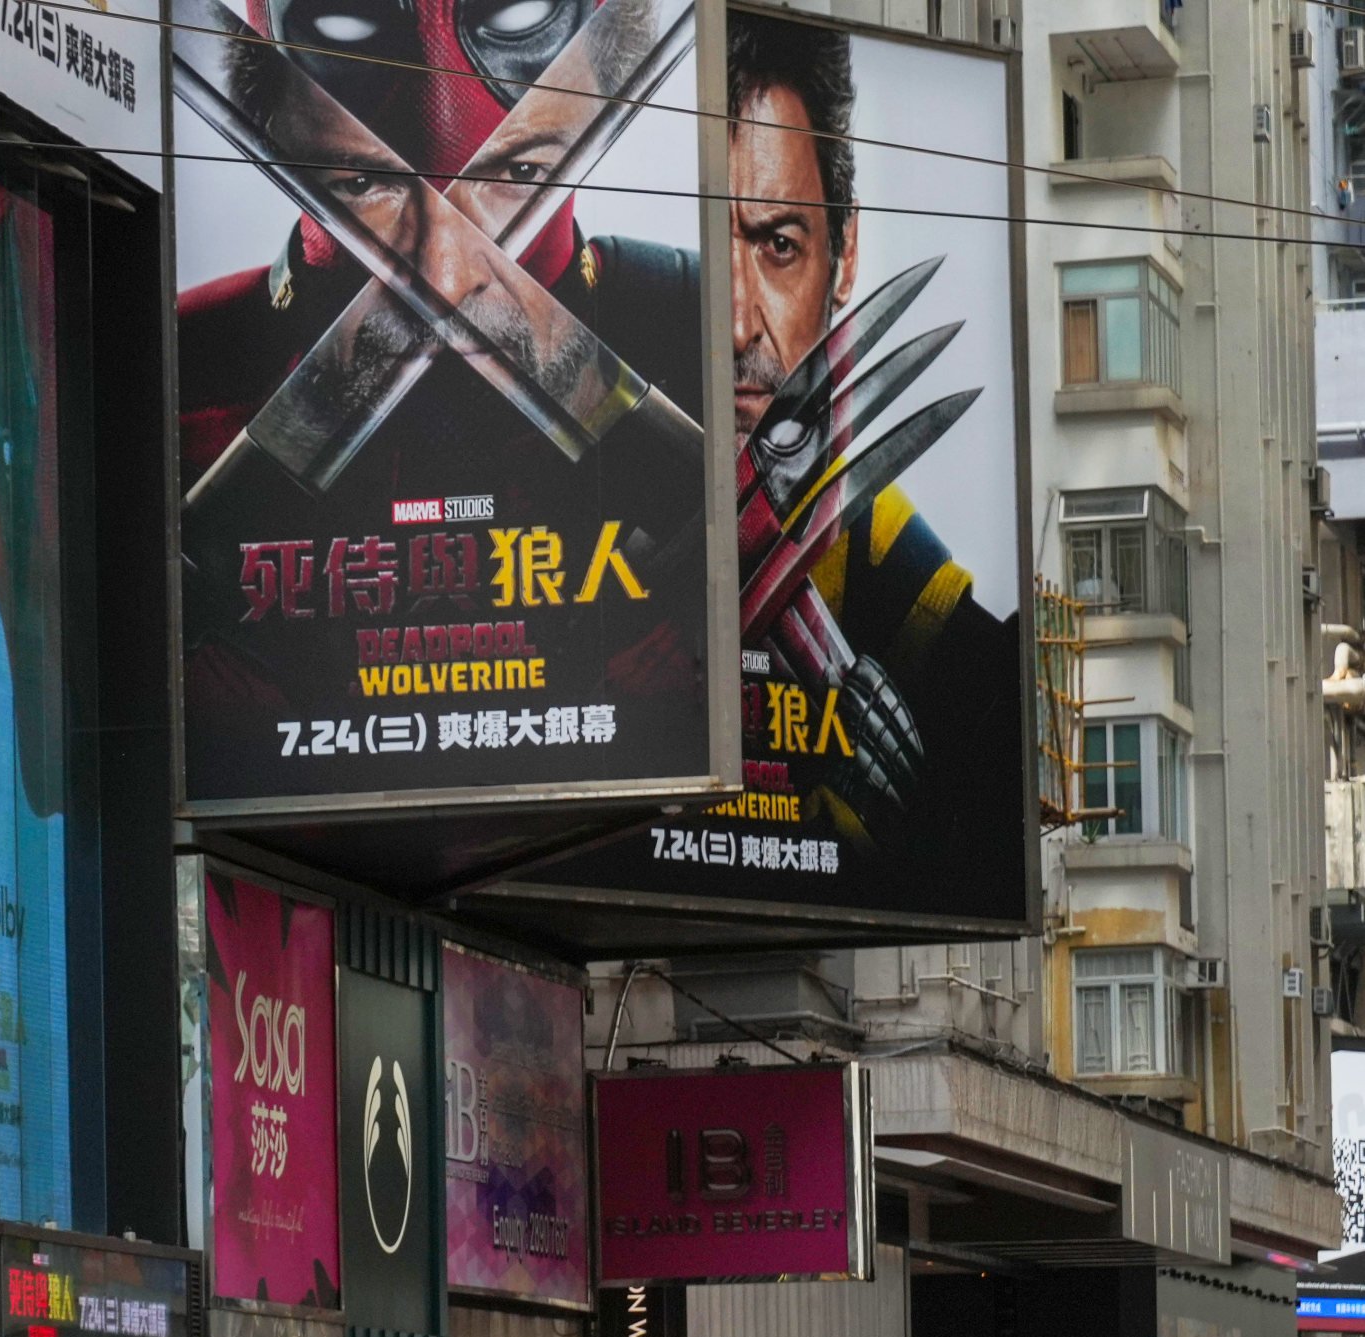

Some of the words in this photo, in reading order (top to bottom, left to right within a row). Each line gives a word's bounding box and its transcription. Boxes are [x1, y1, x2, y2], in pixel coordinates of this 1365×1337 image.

[393, 499, 443, 524] MARVEL
[444, 495, 494, 521] STUDIOS
[238, 520, 651, 623] 死侍與狼人
[356, 621, 537, 665] DEADPOOL
[742, 651, 770, 673] STUDIOS
[358, 657, 546, 697] WOLVERINE
[277, 713, 427, 757] 7.24(三)
[438, 704, 616, 751] 爽爆大銀幕
[650, 828, 736, 866] 7.24(三)
[741, 835, 839, 874] 爽爆大銀幕
[251, 1100, 288, 1179] 莎莎
[713, 1208, 844, 1233] BEVERLEY
